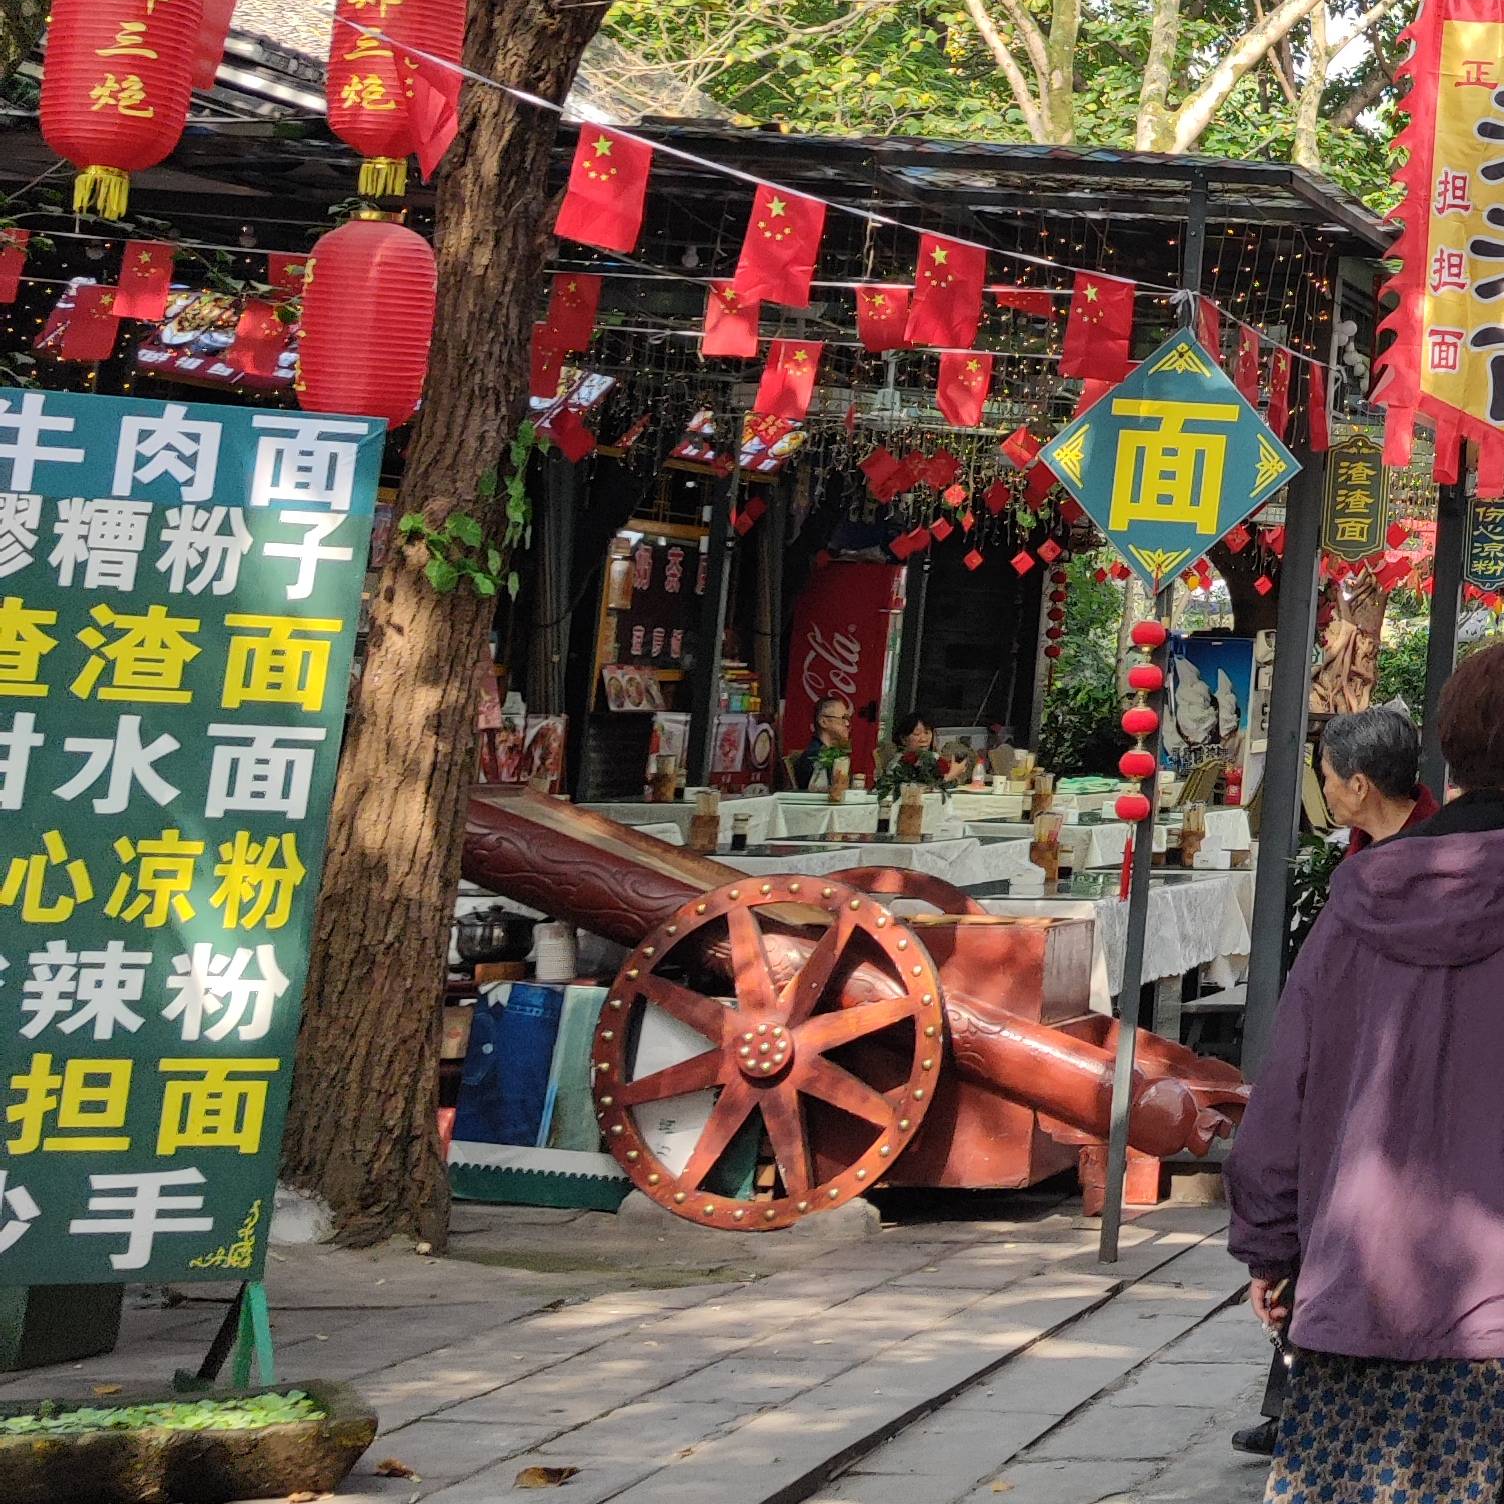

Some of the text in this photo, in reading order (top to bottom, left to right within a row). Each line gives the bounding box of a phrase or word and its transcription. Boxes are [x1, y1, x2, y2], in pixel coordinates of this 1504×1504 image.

[1427, 169, 1473, 372] 担担面
[0, 392, 370, 512] 牛肉面
[1107, 398, 1240, 535] 面
[1335, 459, 1377, 544] 渣渣面
[6, 1052, 281, 1157] 担面
[0, 1166, 214, 1271] 手
